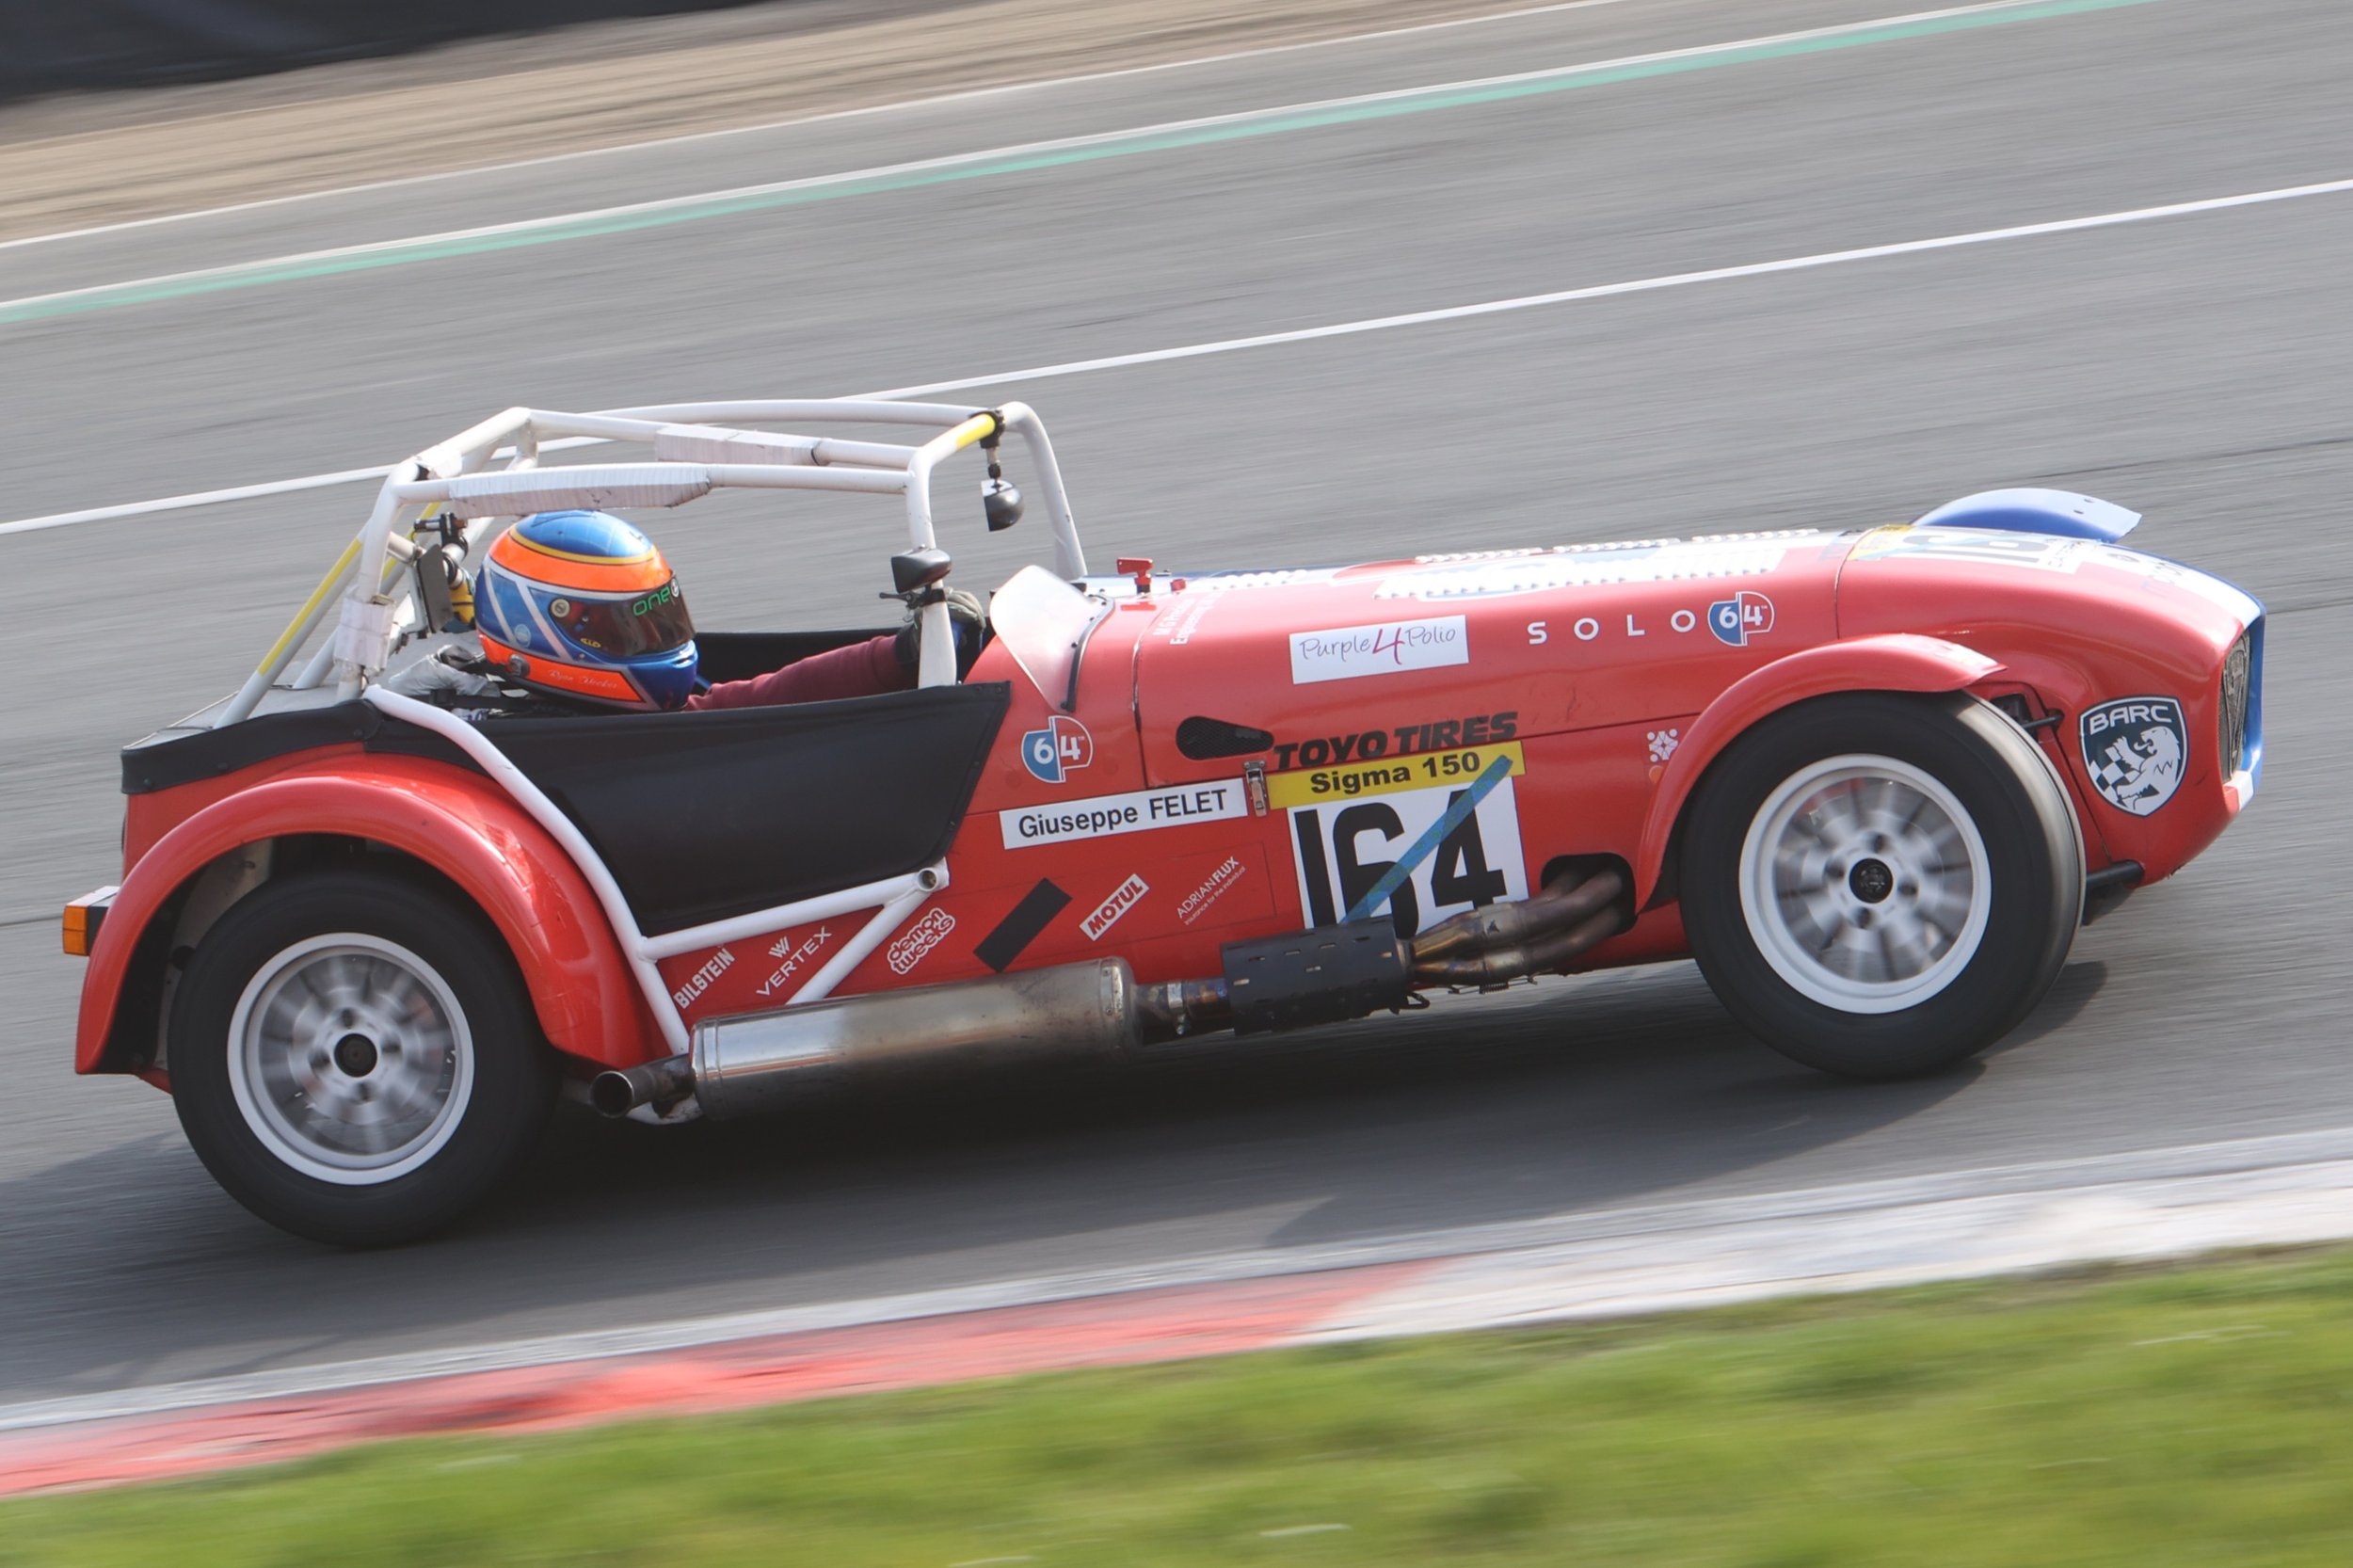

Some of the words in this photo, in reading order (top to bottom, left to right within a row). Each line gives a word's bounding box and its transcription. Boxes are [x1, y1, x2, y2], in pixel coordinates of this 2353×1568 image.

[1527, 609, 1696, 646] SOLO
[1719, 604, 1763, 630] 64
[1273, 729, 1388, 771] TOYO
[1394, 711, 1518, 754] TIRES
[2089, 704, 2172, 736] BARC
[1033, 735, 1081, 765] 64
[1309, 763, 1412, 795] Sigma
[1422, 751, 1481, 778] 150
[1018, 806, 1139, 839] Giuseppe
[1148, 789, 1227, 820] FELET
[1293, 787, 1508, 940] 164
[1087, 880, 1144, 936] MOTUL
[756, 925, 833, 997] VERTEX
[888, 909, 945, 961] demon
[673, 948, 736, 1010] BILSTEIN
